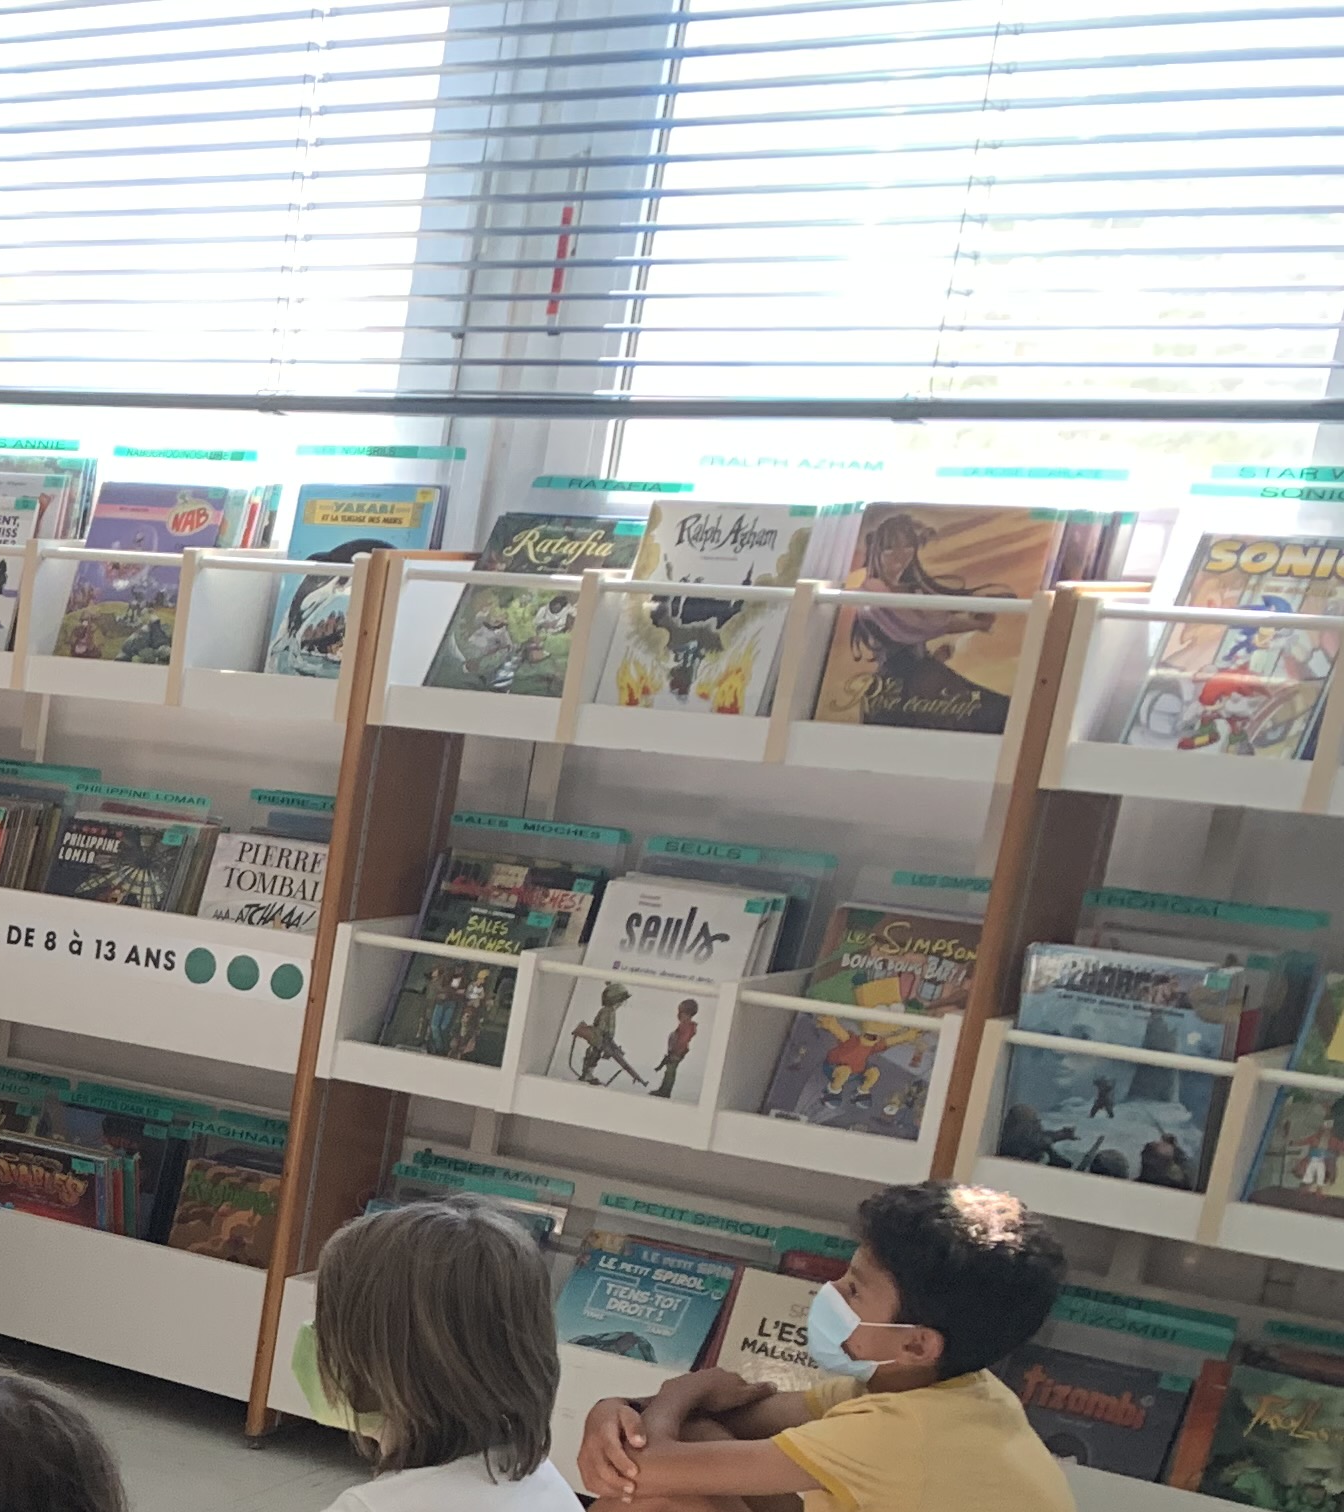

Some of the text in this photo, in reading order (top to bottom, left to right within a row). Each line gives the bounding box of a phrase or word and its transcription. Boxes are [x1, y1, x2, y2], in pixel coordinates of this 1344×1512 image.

[566, 478, 663, 493] RATAFIA
[1238, 466, 1320, 480] STAR
[169, 507, 210, 533] NAB
[674, 512, 779, 551] Ralph Azham
[502, 524, 615, 566] Ratafia
[75, 783, 207, 807] PHILIPPINE LOMAR
[454, 813, 602, 840] SALES MIOCHES
[62, 831, 122, 854] PHILIPPINE
[664, 840, 742, 860] SEULS
[57, 847, 96, 864] LOMAR
[237, 839, 328, 876] PIERRE
[465, 914, 510, 935] SALES
[618, 905, 731, 964] seuls
[6, 924, 35, 947] DE
[44, 930, 57, 951] 8
[68, 929, 83, 956] à
[95, 938, 116, 961] 13
[124, 944, 177, 971] ANS
[444, 927, 522, 954] MIOCHES!
[840, 952, 885, 972] BOING
[602, 1194, 771, 1240] LE PETIT SPIROU
[598, 1255, 618, 1271] LE
